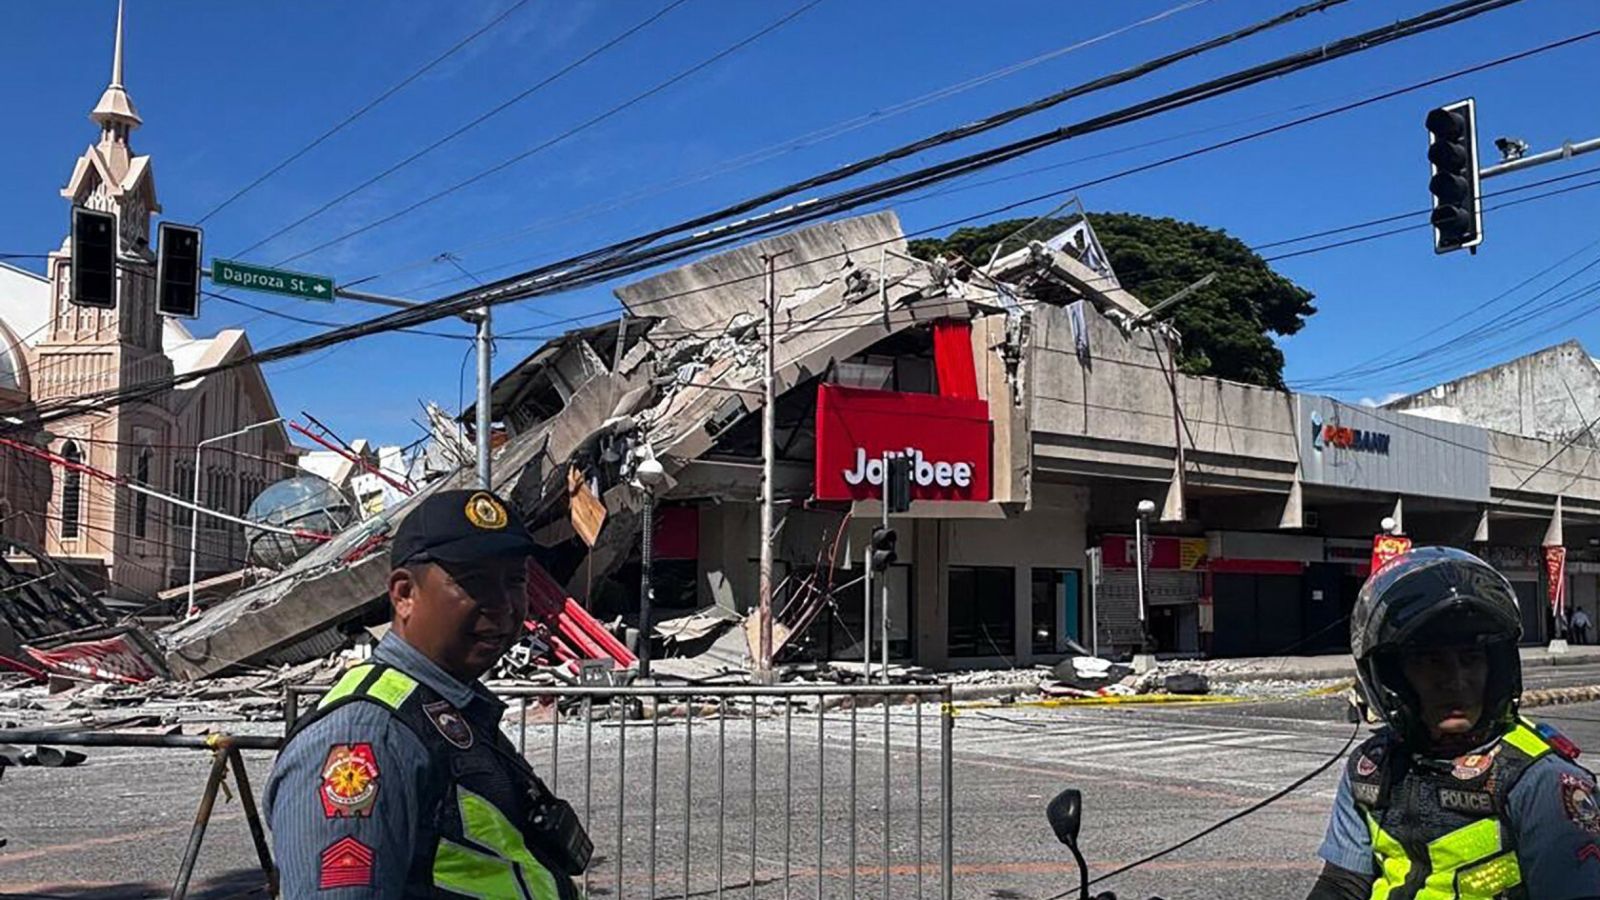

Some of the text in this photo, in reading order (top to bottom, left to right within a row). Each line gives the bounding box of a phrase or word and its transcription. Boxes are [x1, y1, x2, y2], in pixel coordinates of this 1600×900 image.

[223, 267, 308, 292] Daproza St.
[844, 447, 972, 487] Joibee
[1440, 789, 1492, 811] POLICE
